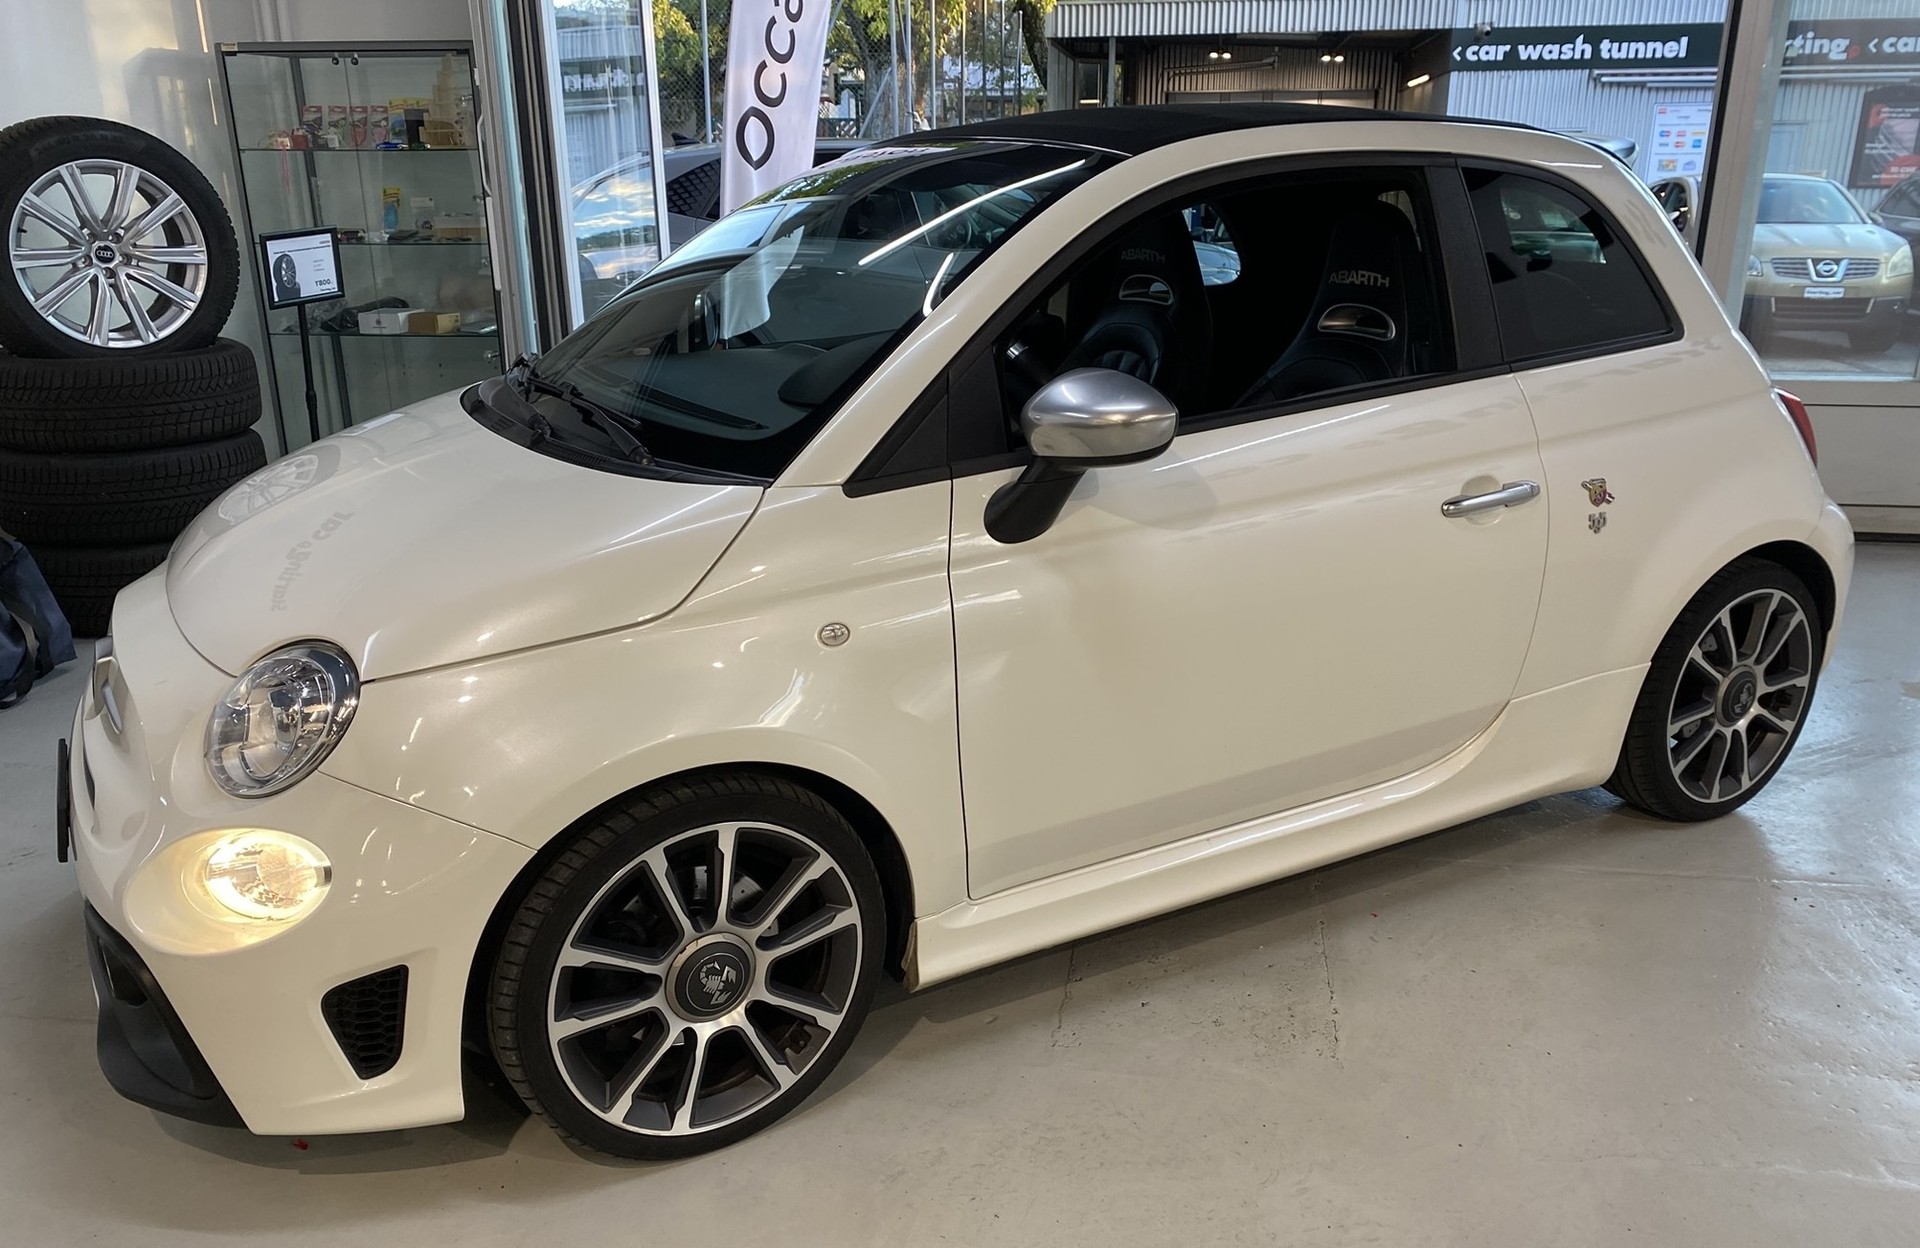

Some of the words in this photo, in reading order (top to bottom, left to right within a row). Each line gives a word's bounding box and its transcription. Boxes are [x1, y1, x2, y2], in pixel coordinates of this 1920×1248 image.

[1465, 43, 1511, 62] car
[1518, 33, 1593, 61] wash
[1599, 36, 1688, 60] tunnel
[1121, 247, 1166, 264] ABARTH
[1328, 269, 1391, 288] ABARTH
